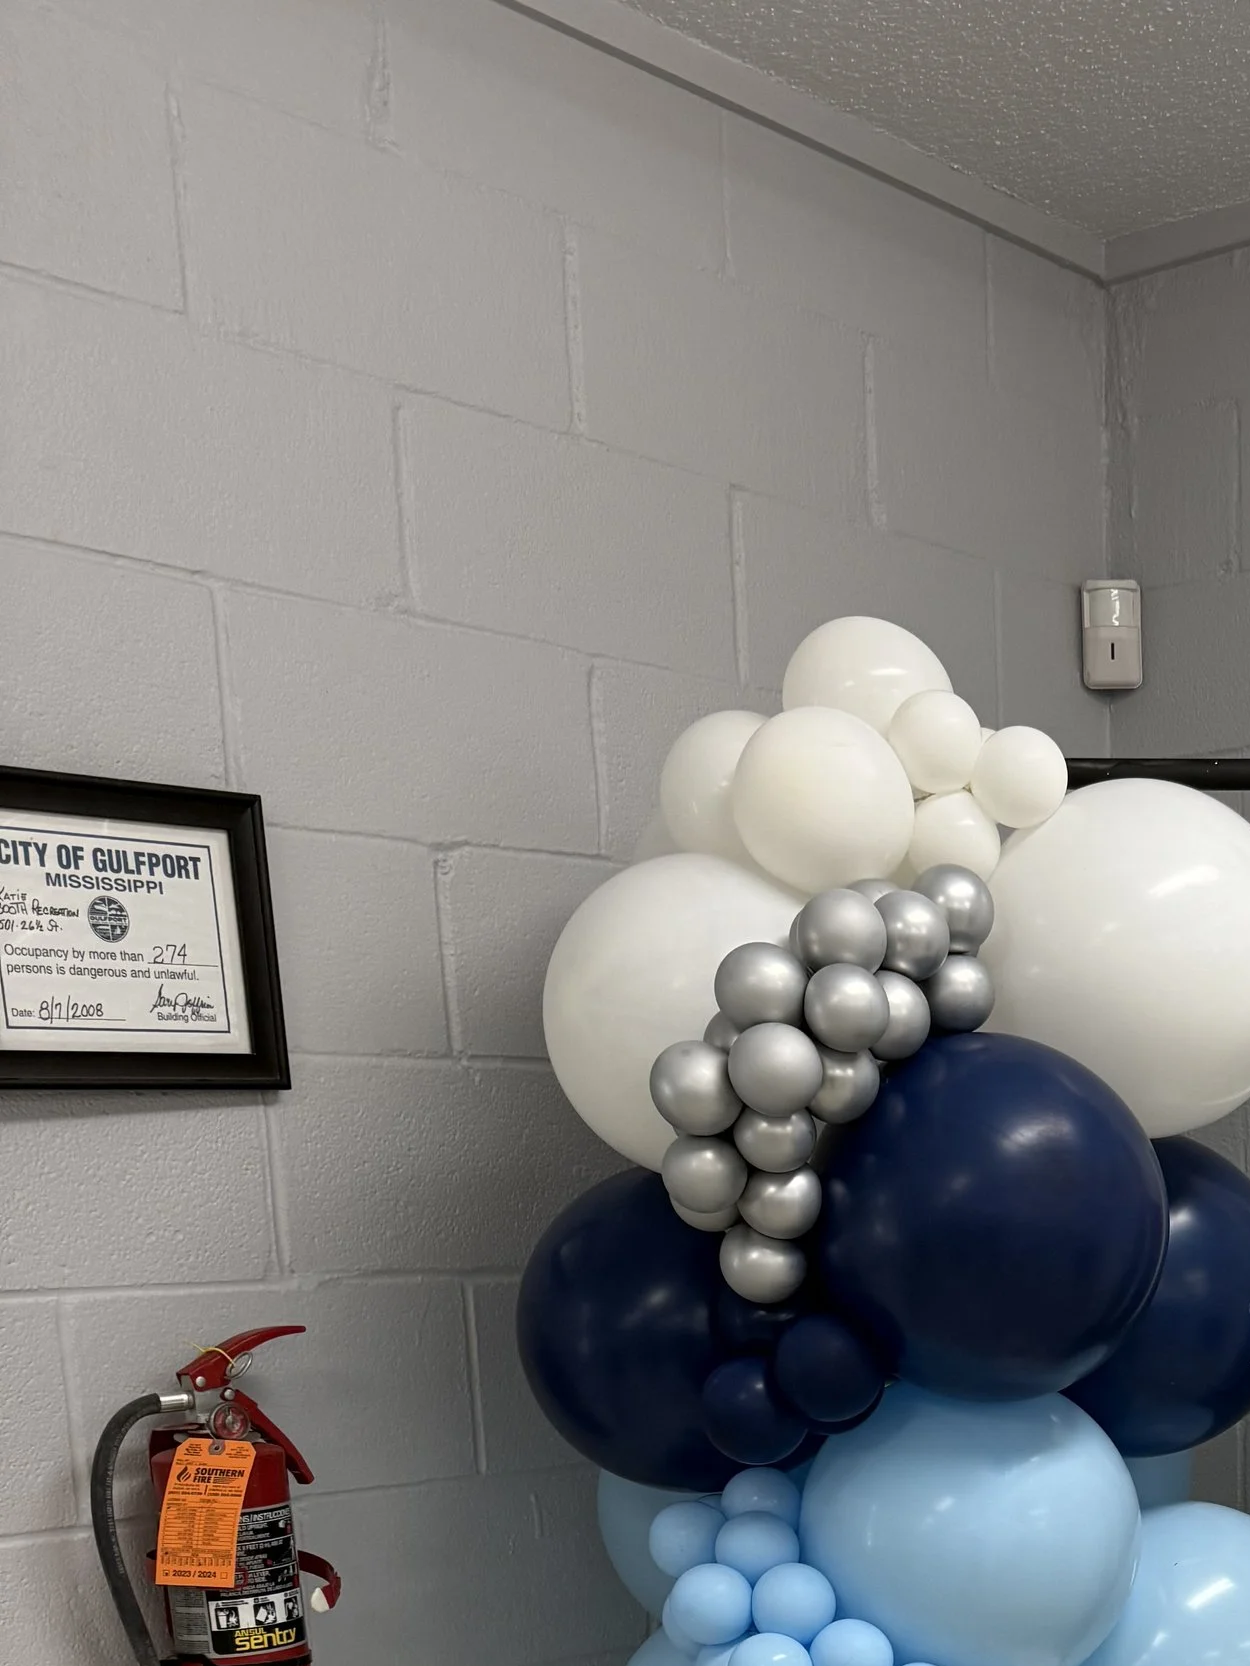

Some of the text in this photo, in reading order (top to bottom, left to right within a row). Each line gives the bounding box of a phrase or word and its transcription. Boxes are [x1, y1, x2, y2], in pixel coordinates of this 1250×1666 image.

[0, 838, 201, 880] CITY OF GULFPORT
[46, 872, 164, 895] MISSISSIPPI
[4, 943, 187, 965] Occupancy by more than 274
[6, 963, 199, 980] persons is dangerous and unlawful.
[11, 1008, 36, 1018] Date:
[157, 1012, 217, 1023] Building Official
[194, 1467, 246, 1477] SOUTHERN
[193, 1475, 212, 1484] FIRE
[172, 1569, 191, 1578] 2023
[197, 1570, 217, 1578] 2024
[234, 1627, 268, 1638] ANSUL
[234, 1627, 297, 1652] sentry
